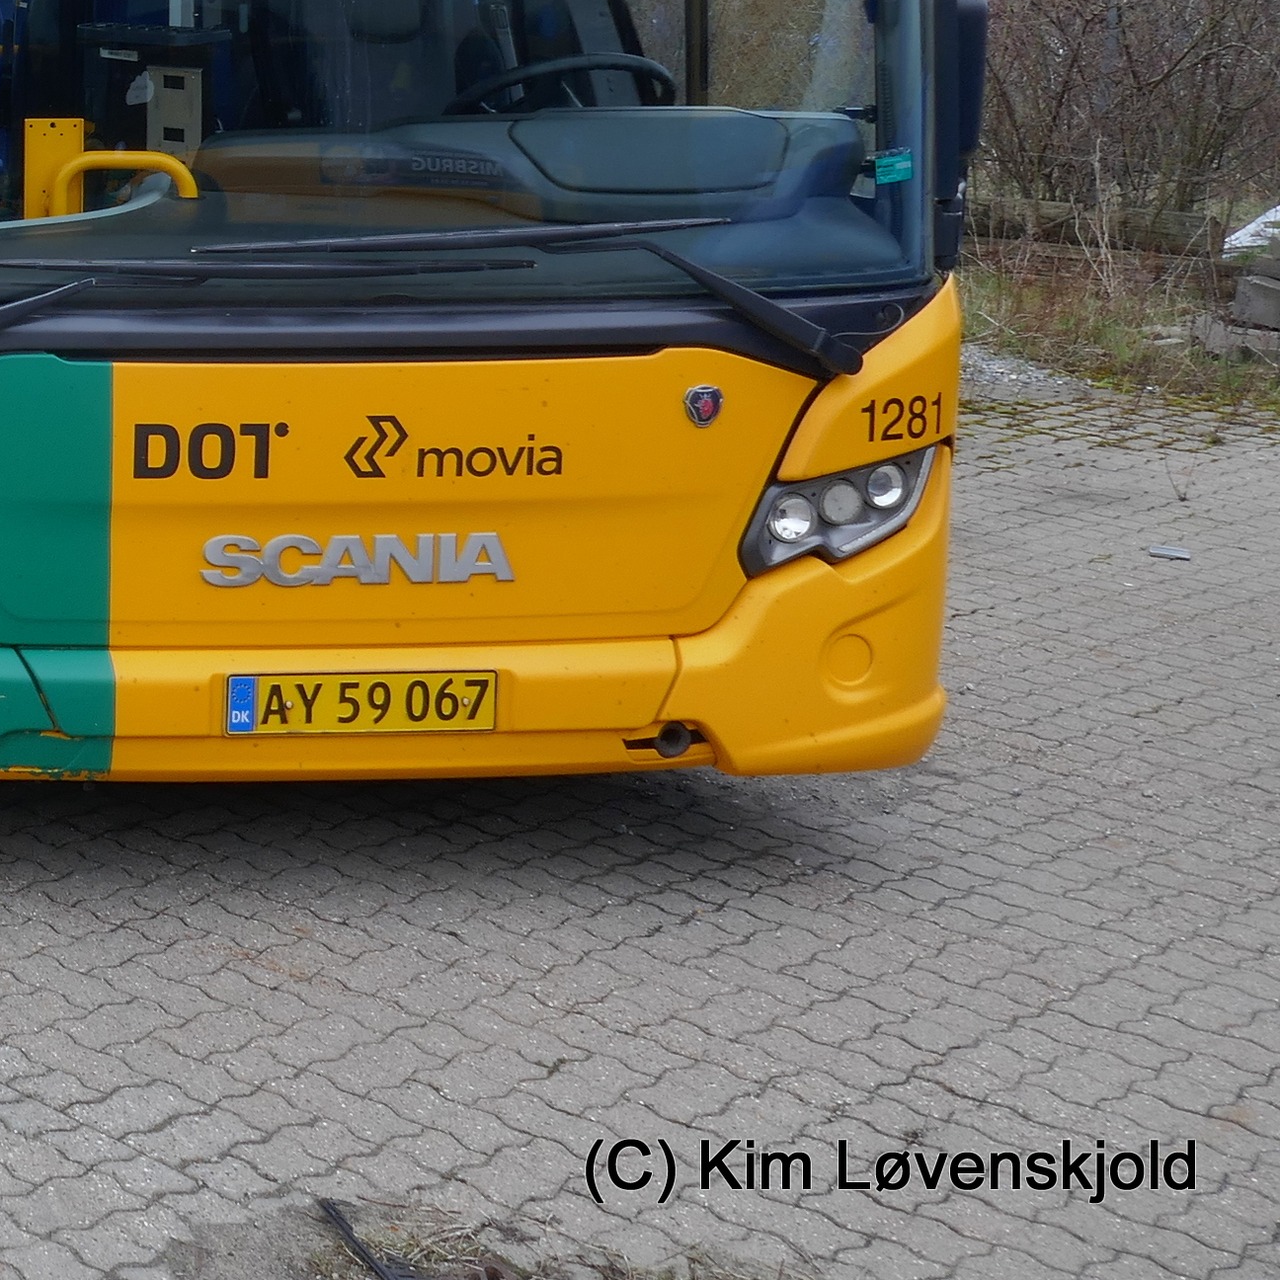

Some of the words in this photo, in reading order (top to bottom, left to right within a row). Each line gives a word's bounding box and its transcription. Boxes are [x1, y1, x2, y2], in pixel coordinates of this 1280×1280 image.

[860, 391, 942, 443] 1281
[133, 422, 273, 480] DOT
[416, 433, 564, 478] movia
[199, 531, 516, 588] SCANIA
[231, 710, 251, 724] DK
[259, 682, 323, 726] AY
[336, 681, 391, 725] 59
[404, 677, 490, 723] 067
